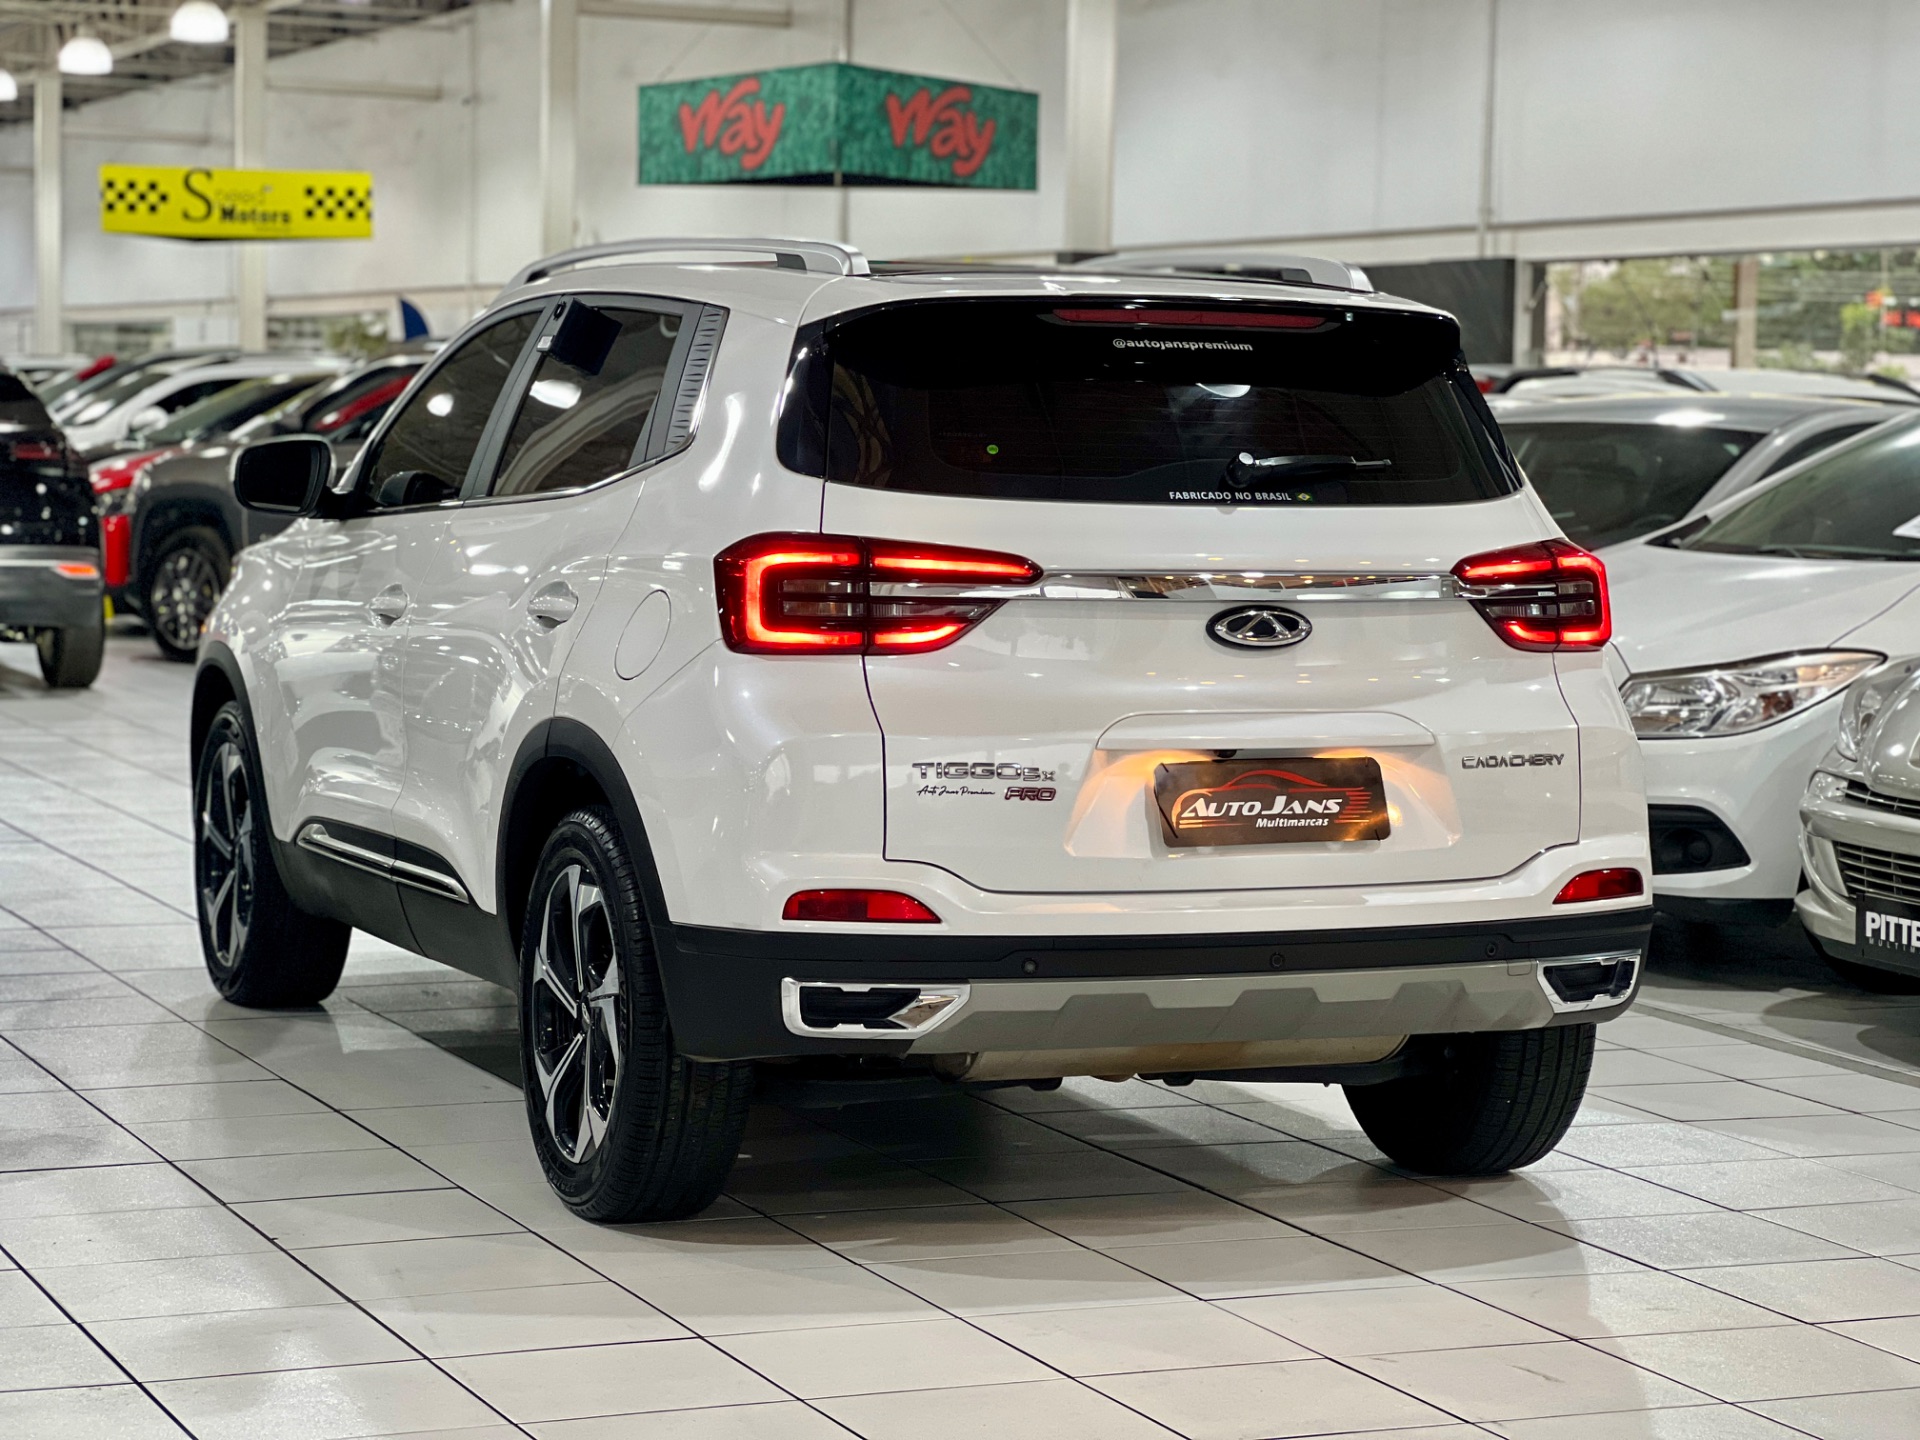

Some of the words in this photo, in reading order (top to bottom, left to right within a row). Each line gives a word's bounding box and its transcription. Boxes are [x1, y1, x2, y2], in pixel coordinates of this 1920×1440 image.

[679, 78, 785, 170] Way
[886, 86, 996, 177] Way
[1112, 338, 1253, 351] @autojanspremium
[1169, 491, 1232, 500] FABRICADO
[1235, 491, 1252, 500] NO
[1255, 492, 1292, 501] BRASIL
[1004, 786, 1057, 801] PRO
[1255, 817, 1329, 828] Multimarcas
